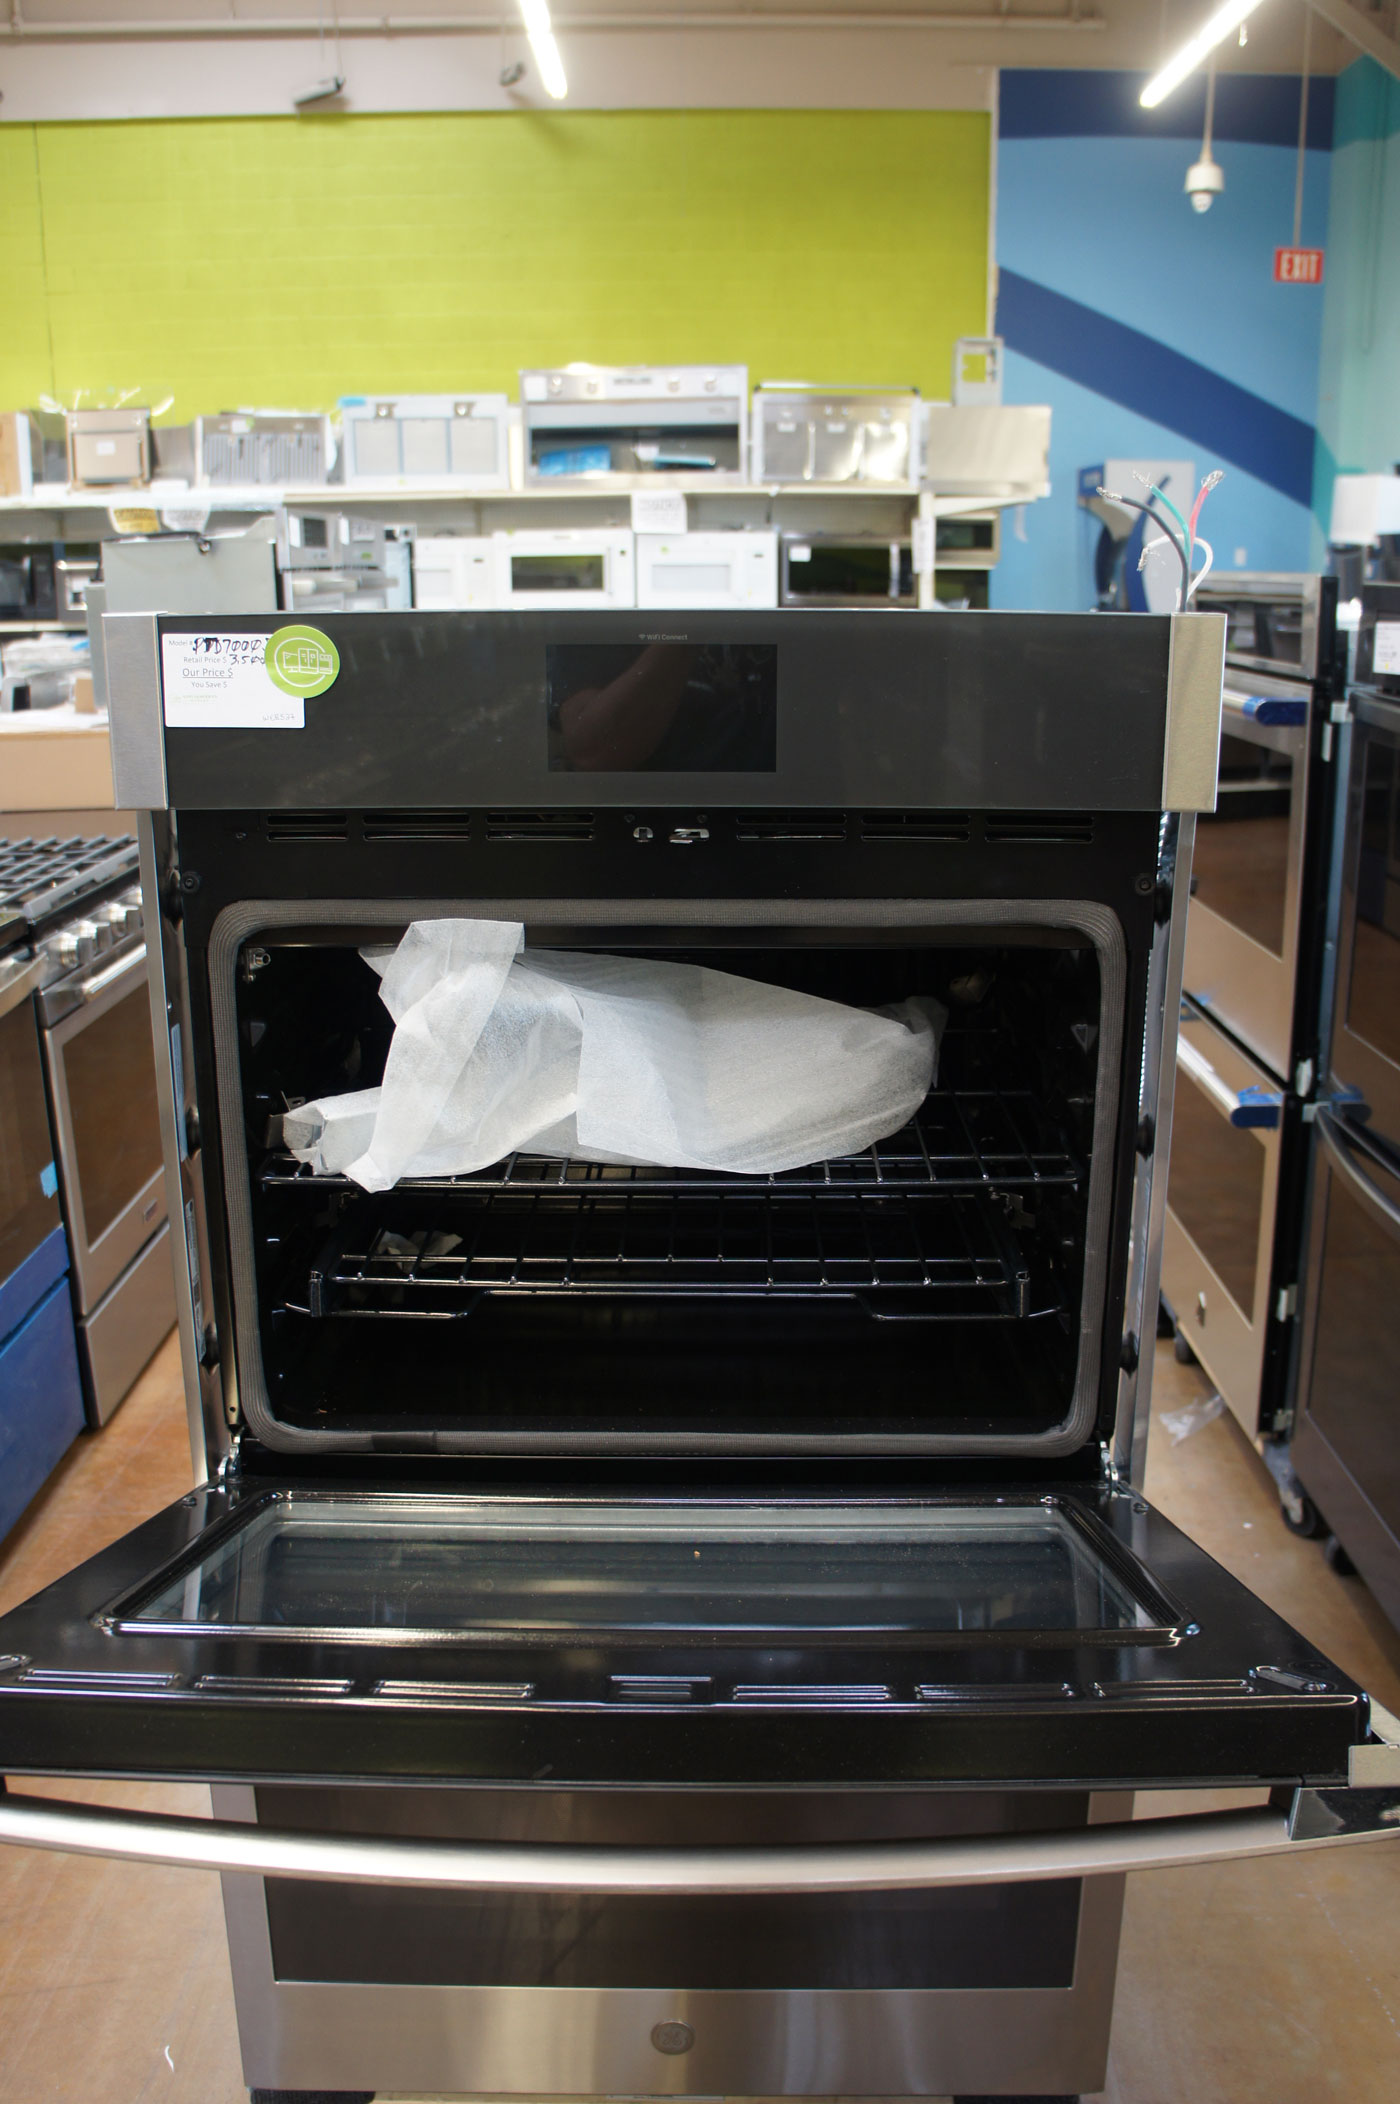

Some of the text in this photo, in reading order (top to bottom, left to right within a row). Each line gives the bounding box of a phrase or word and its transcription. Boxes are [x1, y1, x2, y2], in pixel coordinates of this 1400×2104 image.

[1281, 252, 1320, 281] EXIT
[168, 639, 187, 647] Model
[183, 656, 203, 664] Retail
[204, 656, 221, 664] Price
[182, 667, 234, 678] Our Price $
